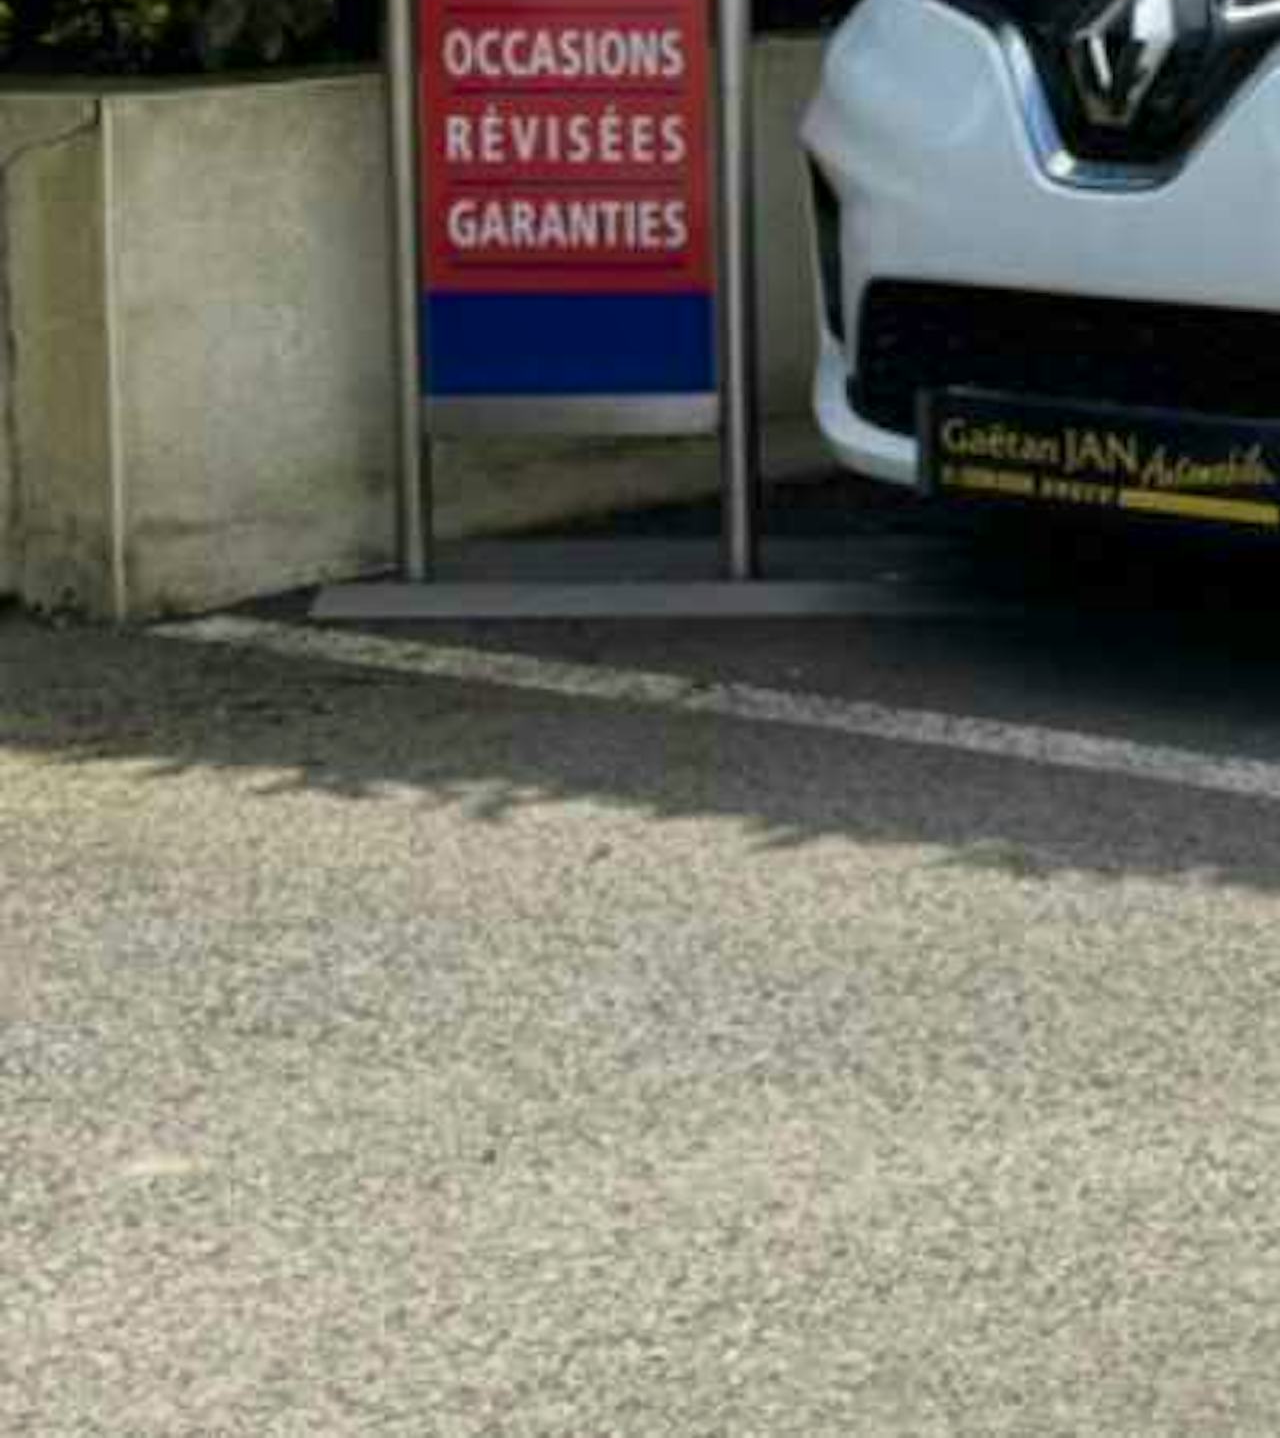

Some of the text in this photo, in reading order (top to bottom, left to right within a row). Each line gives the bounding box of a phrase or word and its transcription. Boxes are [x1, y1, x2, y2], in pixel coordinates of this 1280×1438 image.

[443, 29, 685, 77] OCCASIONS
[445, 104, 686, 163] RÉVISÉES
[447, 200, 687, 249] GARANTIES
[1063, 426, 1139, 474] JAN
